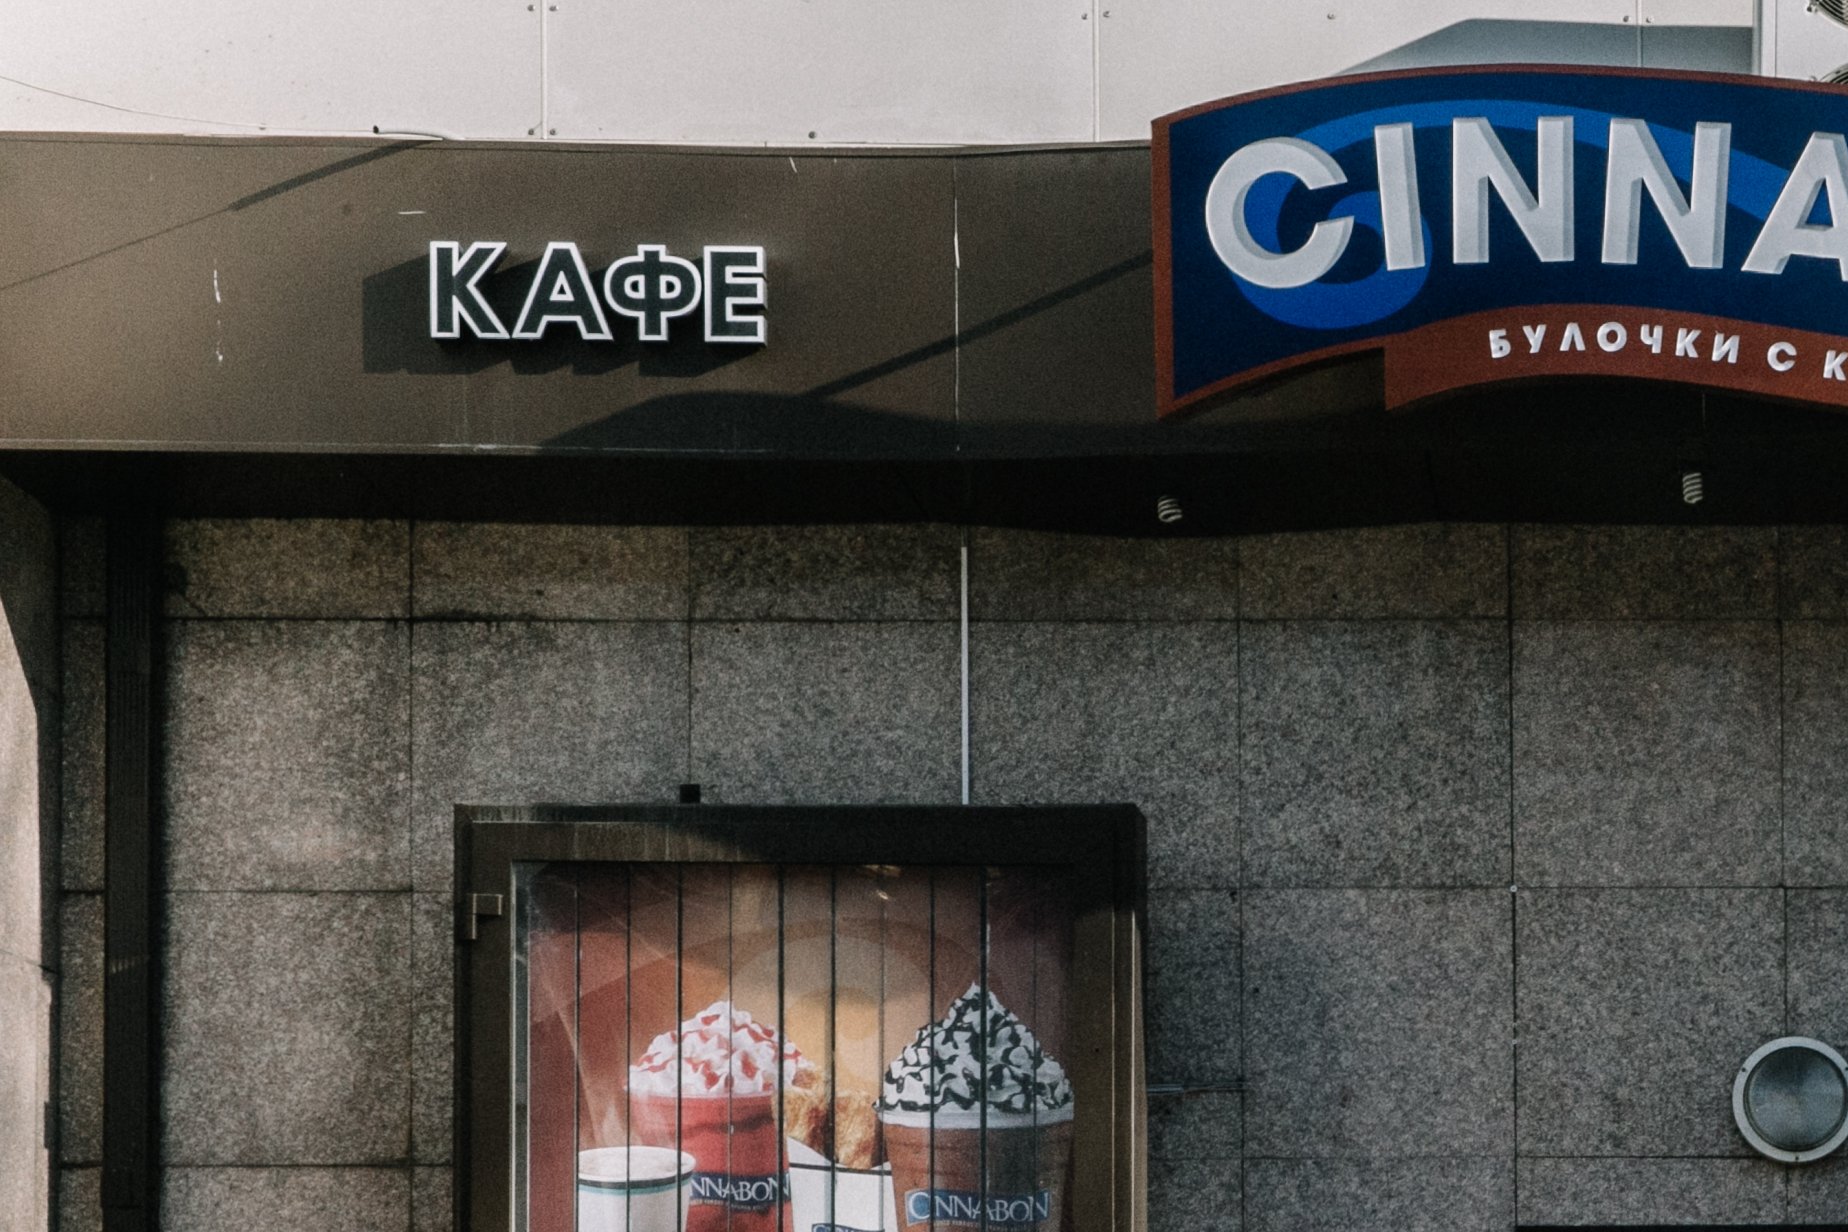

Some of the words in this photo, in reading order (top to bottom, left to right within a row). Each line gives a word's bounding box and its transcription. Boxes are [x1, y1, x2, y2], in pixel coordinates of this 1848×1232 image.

[430, 241, 767, 344] КАФЕ
[1488, 321, 1740, 363] БУЛОЧКИ
[1766, 341, 1797, 372] С
[909, 1191, 1048, 1221] CNNABON
